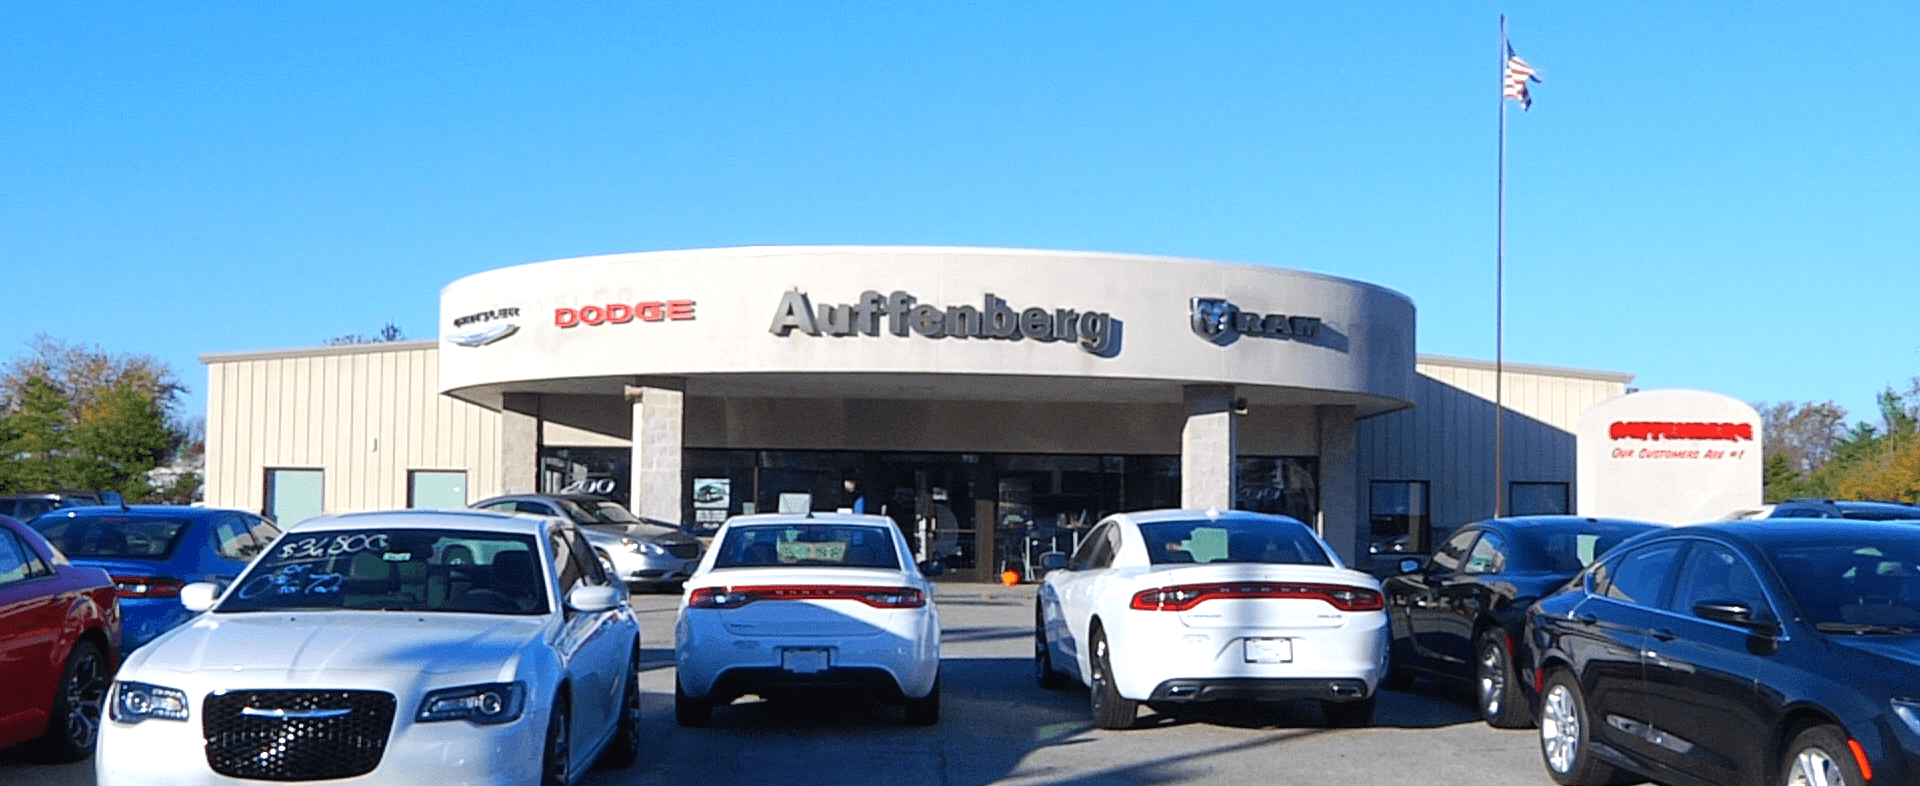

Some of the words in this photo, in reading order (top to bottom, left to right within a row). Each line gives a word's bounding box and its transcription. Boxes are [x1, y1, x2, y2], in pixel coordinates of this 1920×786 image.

[554, 299, 695, 328] DODGE
[769, 288, 1118, 354] Auffenberg
[1237, 312, 1322, 339] RAM
[561, 479, 615, 494] 200
